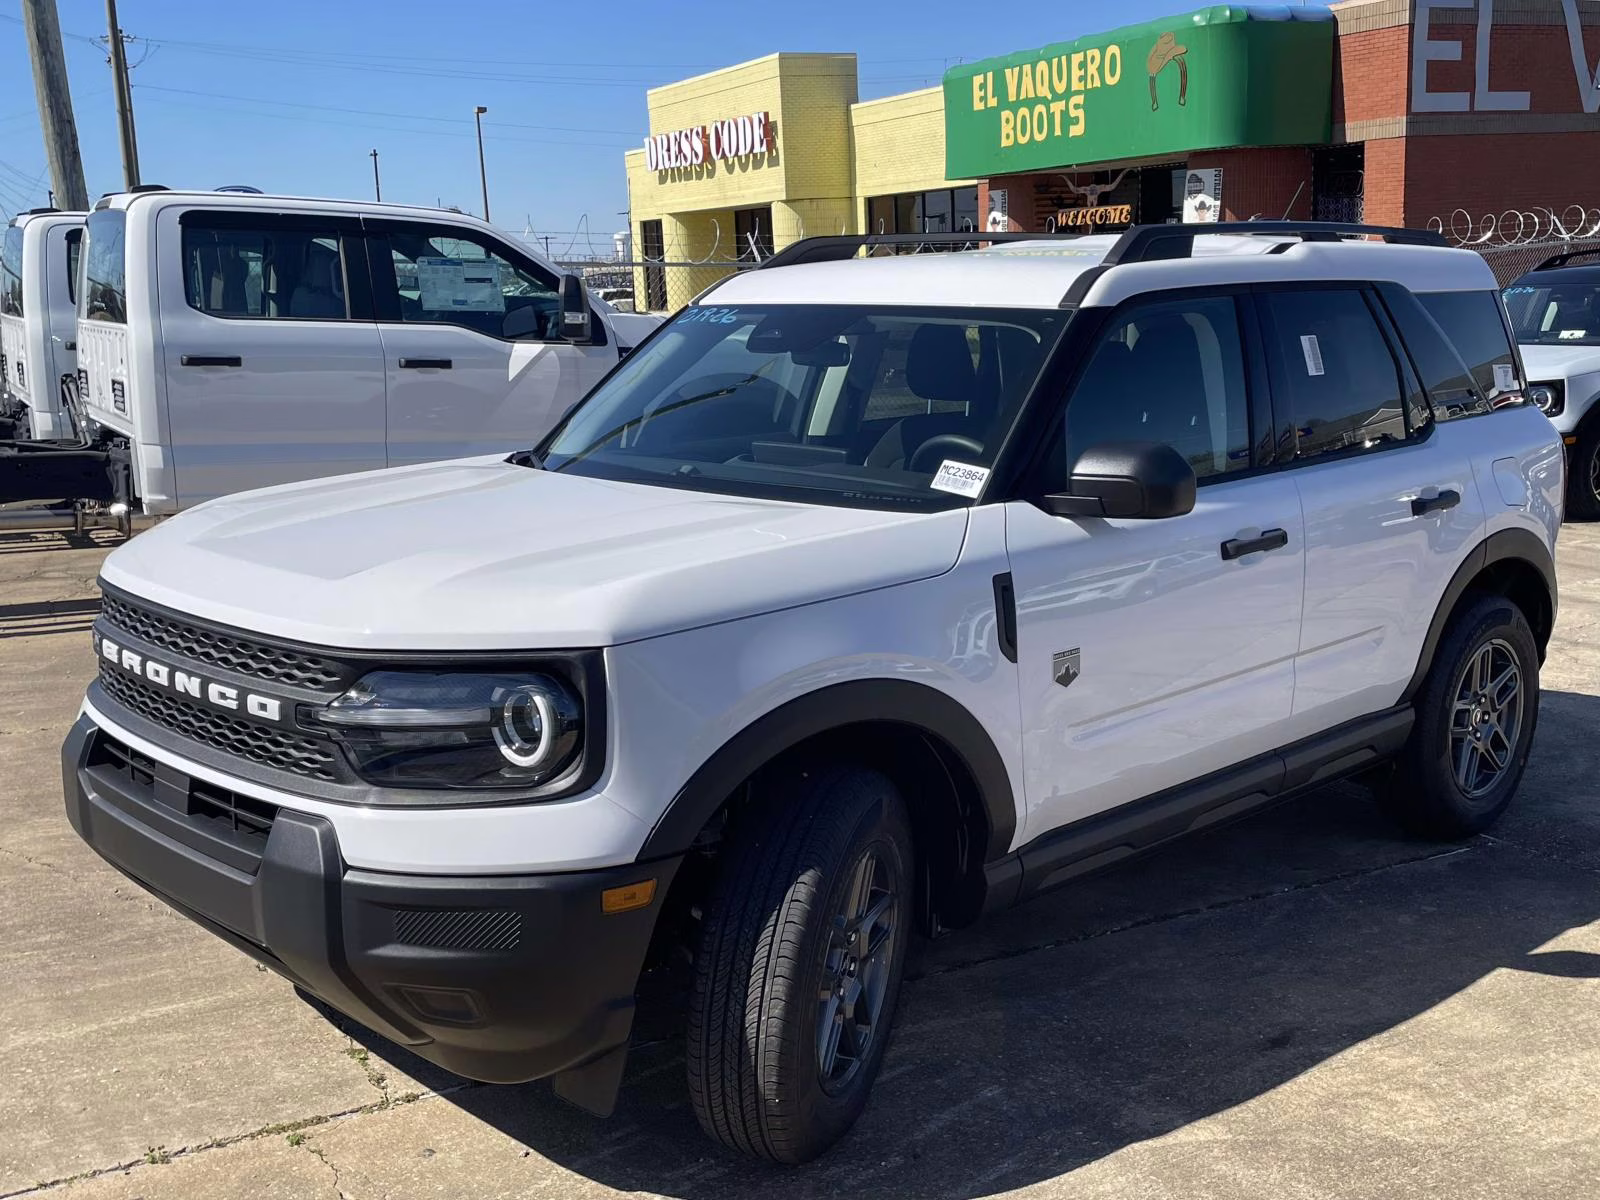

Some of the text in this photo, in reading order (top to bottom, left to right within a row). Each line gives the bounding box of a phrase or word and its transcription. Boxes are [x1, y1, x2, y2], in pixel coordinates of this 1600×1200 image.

[972, 44, 1122, 112] EL VAQUERO
[1411, 0, 1531, 113] EL
[643, 111, 769, 173] DRESS CODE
[1000, 94, 1086, 148] BOOTS
[1057, 204, 1132, 227] WELCOME
[940, 464, 985, 482] MC23864
[102, 638, 281, 721] BRONCO
